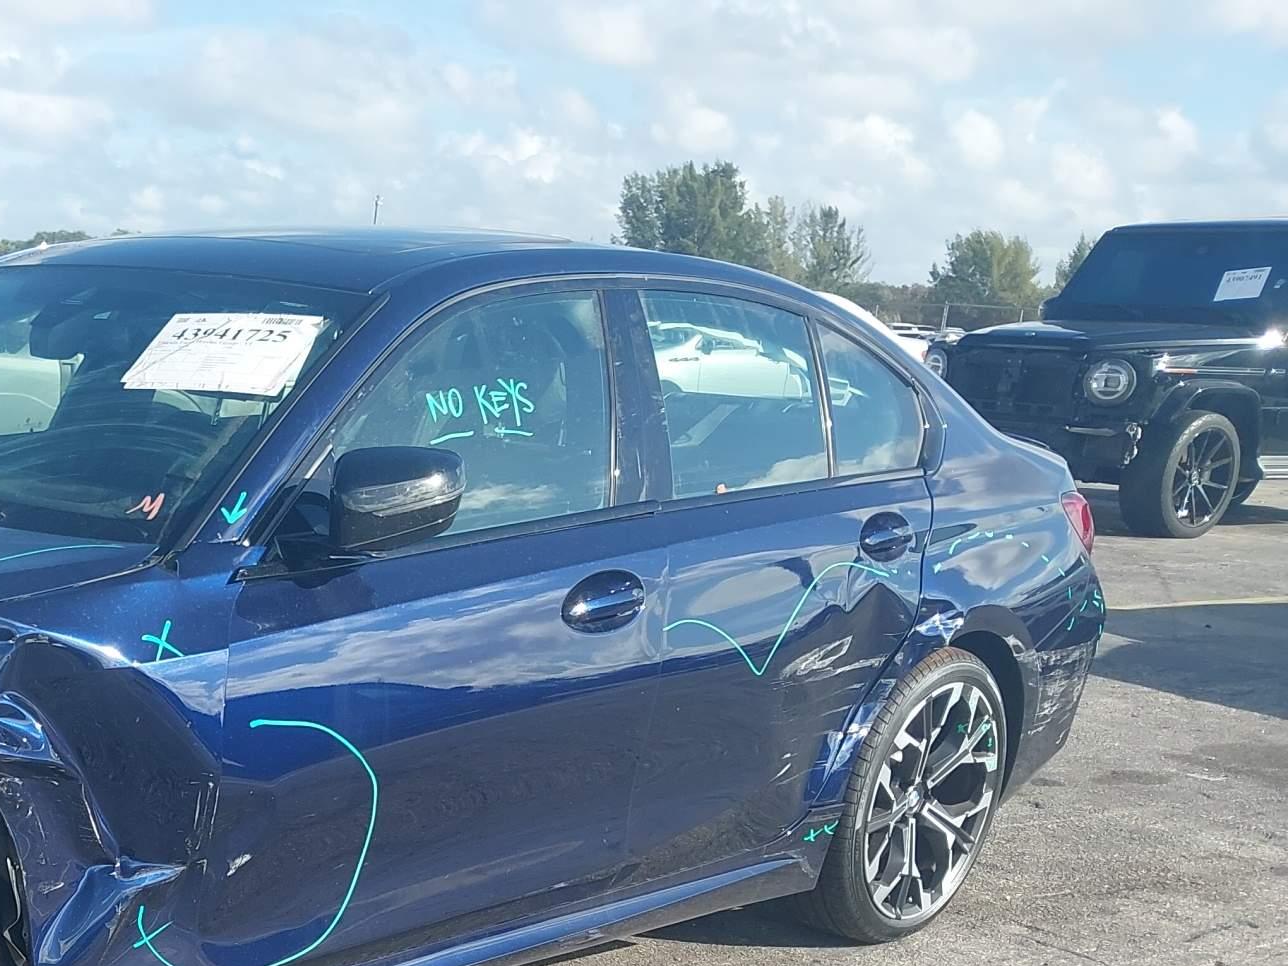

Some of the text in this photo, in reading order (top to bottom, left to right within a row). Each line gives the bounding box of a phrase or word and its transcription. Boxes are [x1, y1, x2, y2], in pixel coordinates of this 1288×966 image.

[172, 327, 291, 343] 43941725
[426, 378, 535, 426] NO KEYS
